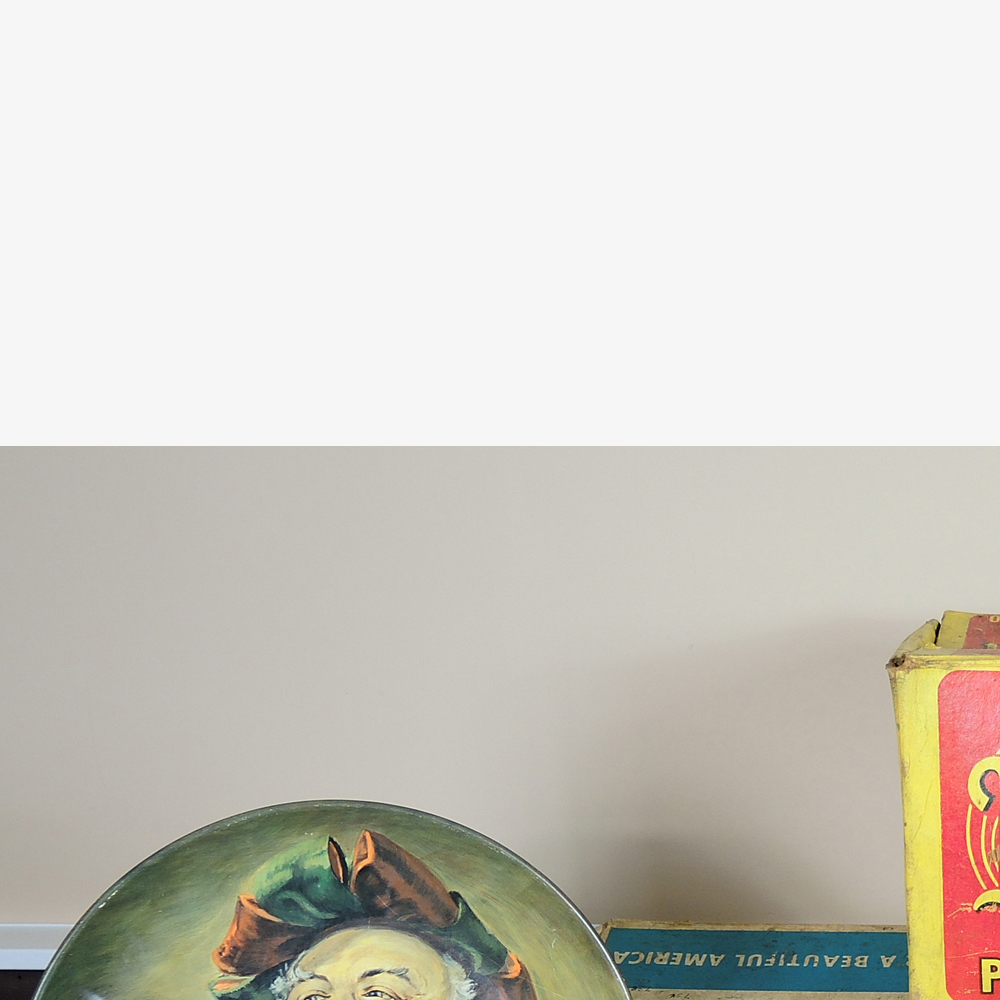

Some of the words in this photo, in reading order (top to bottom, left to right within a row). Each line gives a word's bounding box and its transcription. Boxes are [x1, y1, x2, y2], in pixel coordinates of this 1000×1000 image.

[613, 950, 727, 968] AMERICA
[735, 953, 869, 969] BEAUTIFUL
[880, 955, 897, 969] A
